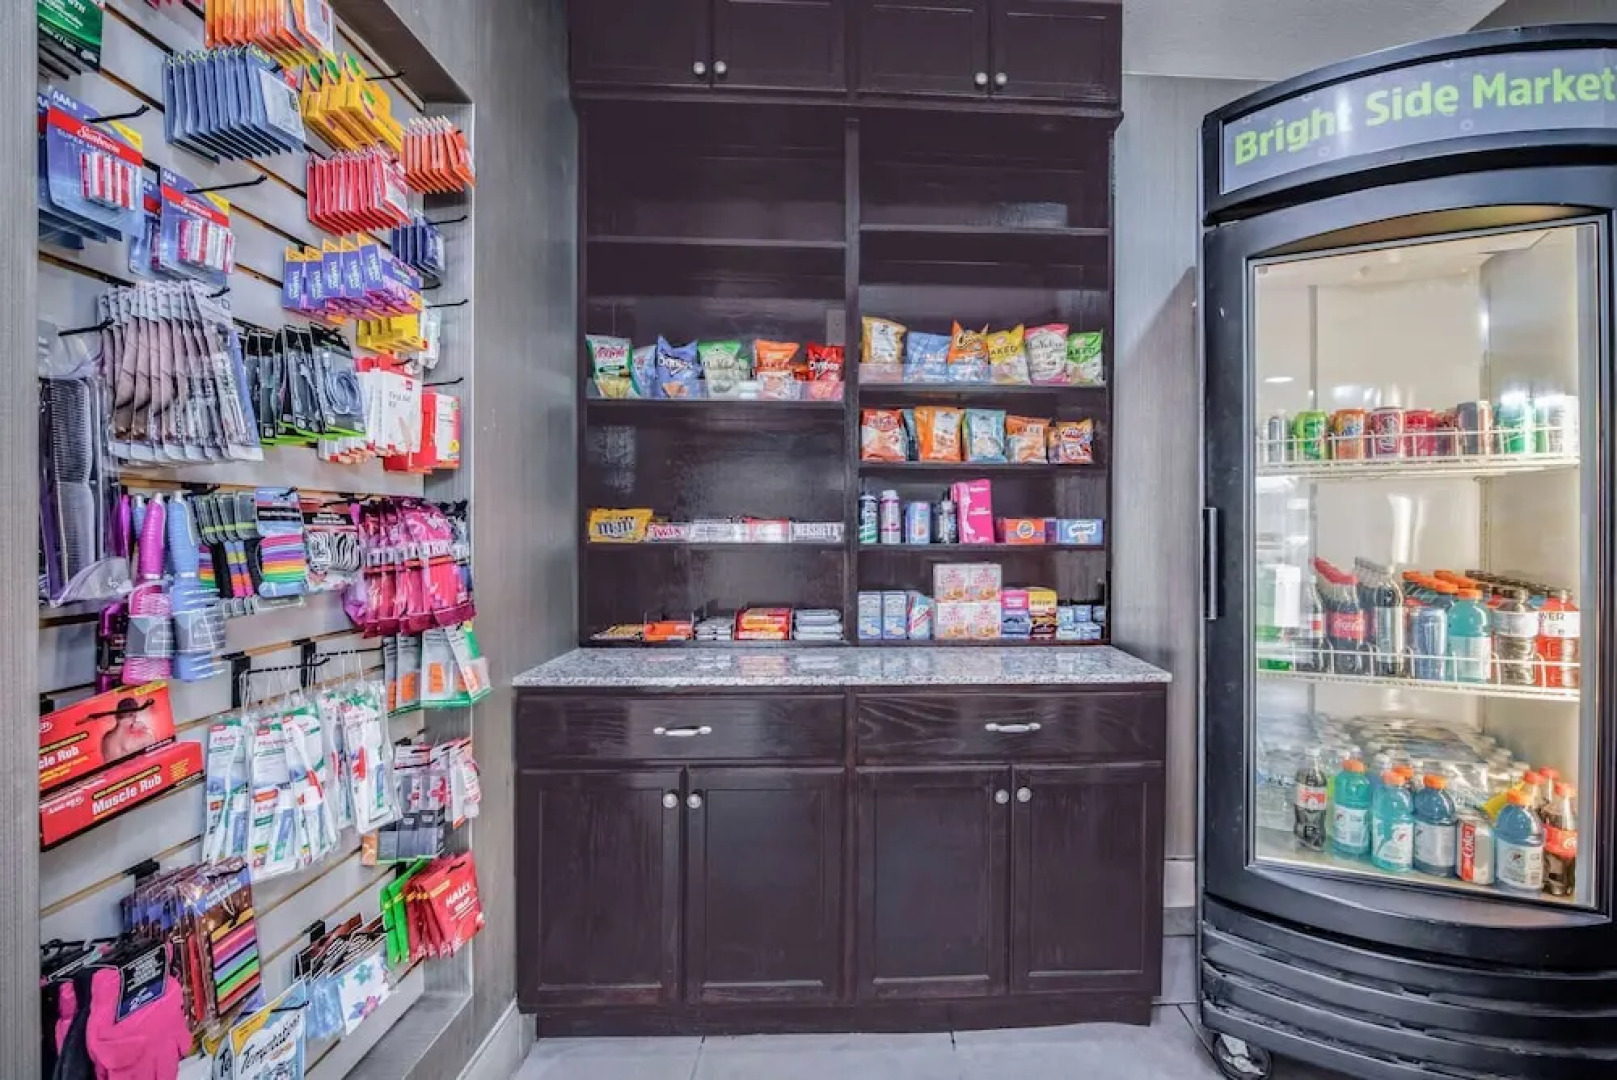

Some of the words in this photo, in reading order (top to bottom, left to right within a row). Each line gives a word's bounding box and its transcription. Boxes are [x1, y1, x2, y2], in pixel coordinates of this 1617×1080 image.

[1235, 106, 1353, 166] Bright
[1366, 81, 1460, 127] Side
[1473, 67, 1616, 110] Market
[57, 746, 79, 760] Rub
[91, 784, 138, 816] Muscle
[139, 774, 162, 792] Rub
